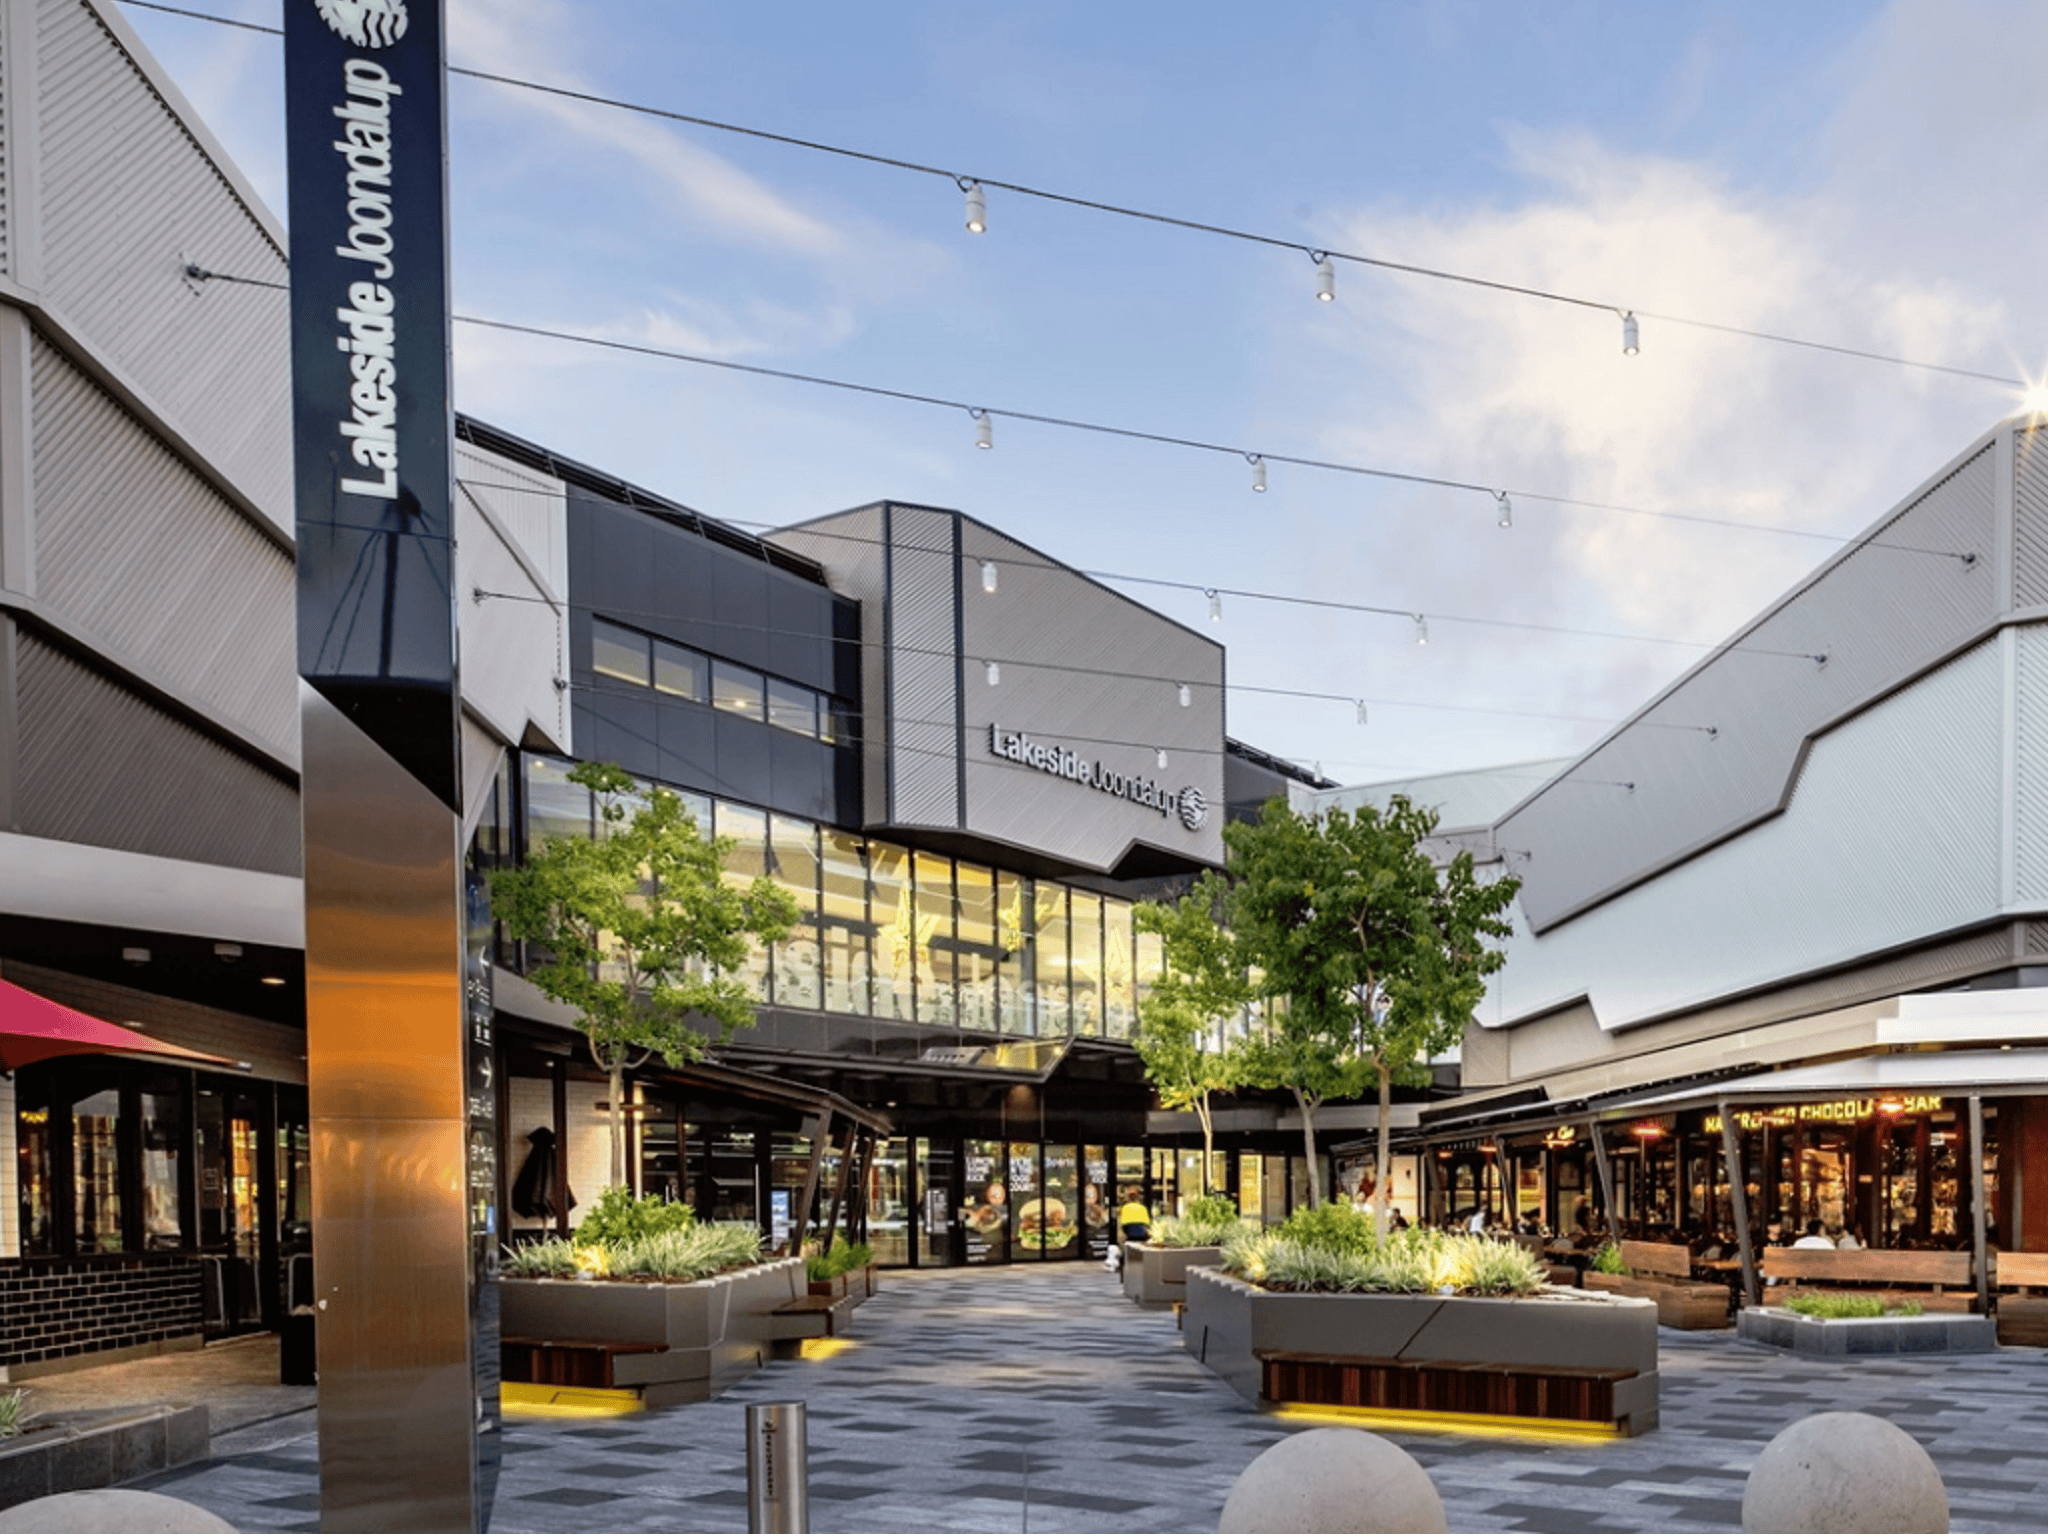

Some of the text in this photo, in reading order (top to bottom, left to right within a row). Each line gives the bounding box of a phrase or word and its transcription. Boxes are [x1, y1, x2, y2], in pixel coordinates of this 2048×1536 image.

[332, 58, 402, 500] Lakeside Joondalup
[990, 722, 1177, 818] Lakeside Joondalup
